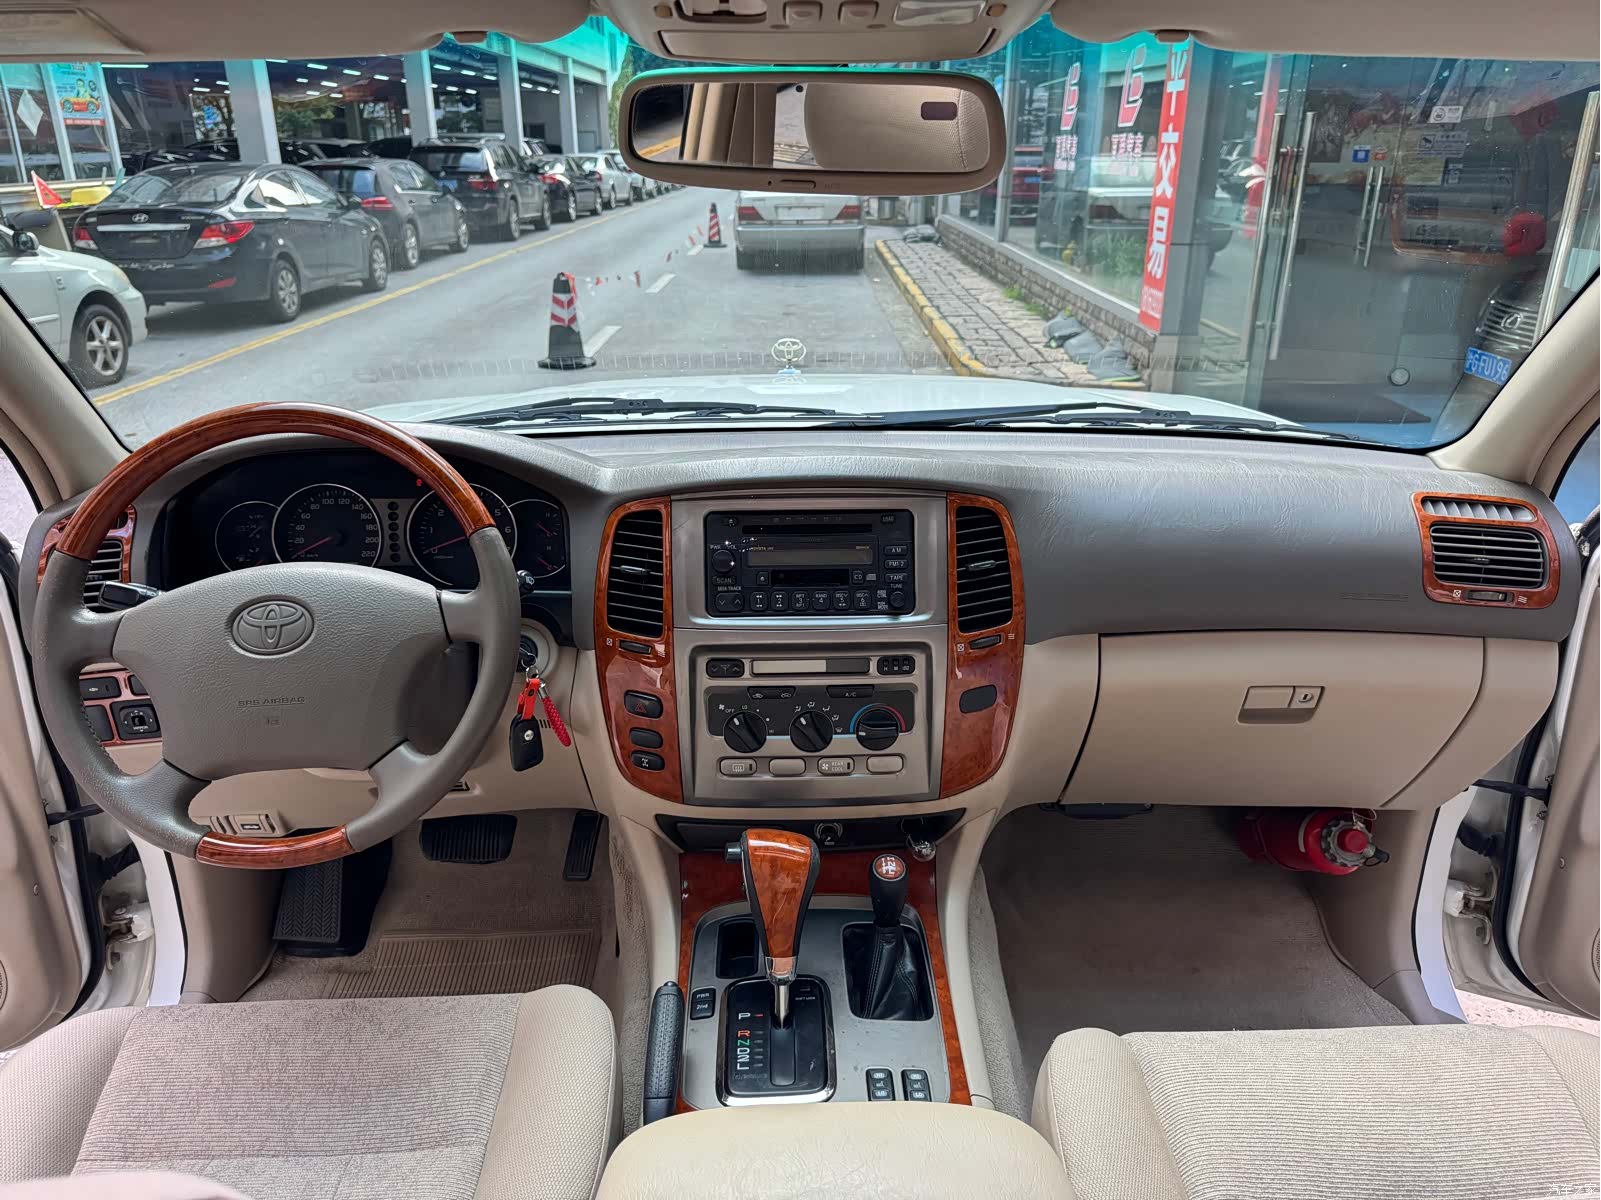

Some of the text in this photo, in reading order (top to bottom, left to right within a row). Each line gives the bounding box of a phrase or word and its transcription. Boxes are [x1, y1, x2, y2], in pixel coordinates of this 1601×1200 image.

[437, 509, 445, 517] 2
[494, 508, 501, 516] 5
[504, 526, 512, 534] 6
[262, 696, 305, 705] AIRBAG
[738, 1012, 751, 1020] P
[737, 1029, 751, 1038] R
[737, 1047, 750, 1055] D
[737, 1054, 750, 1062] 2
